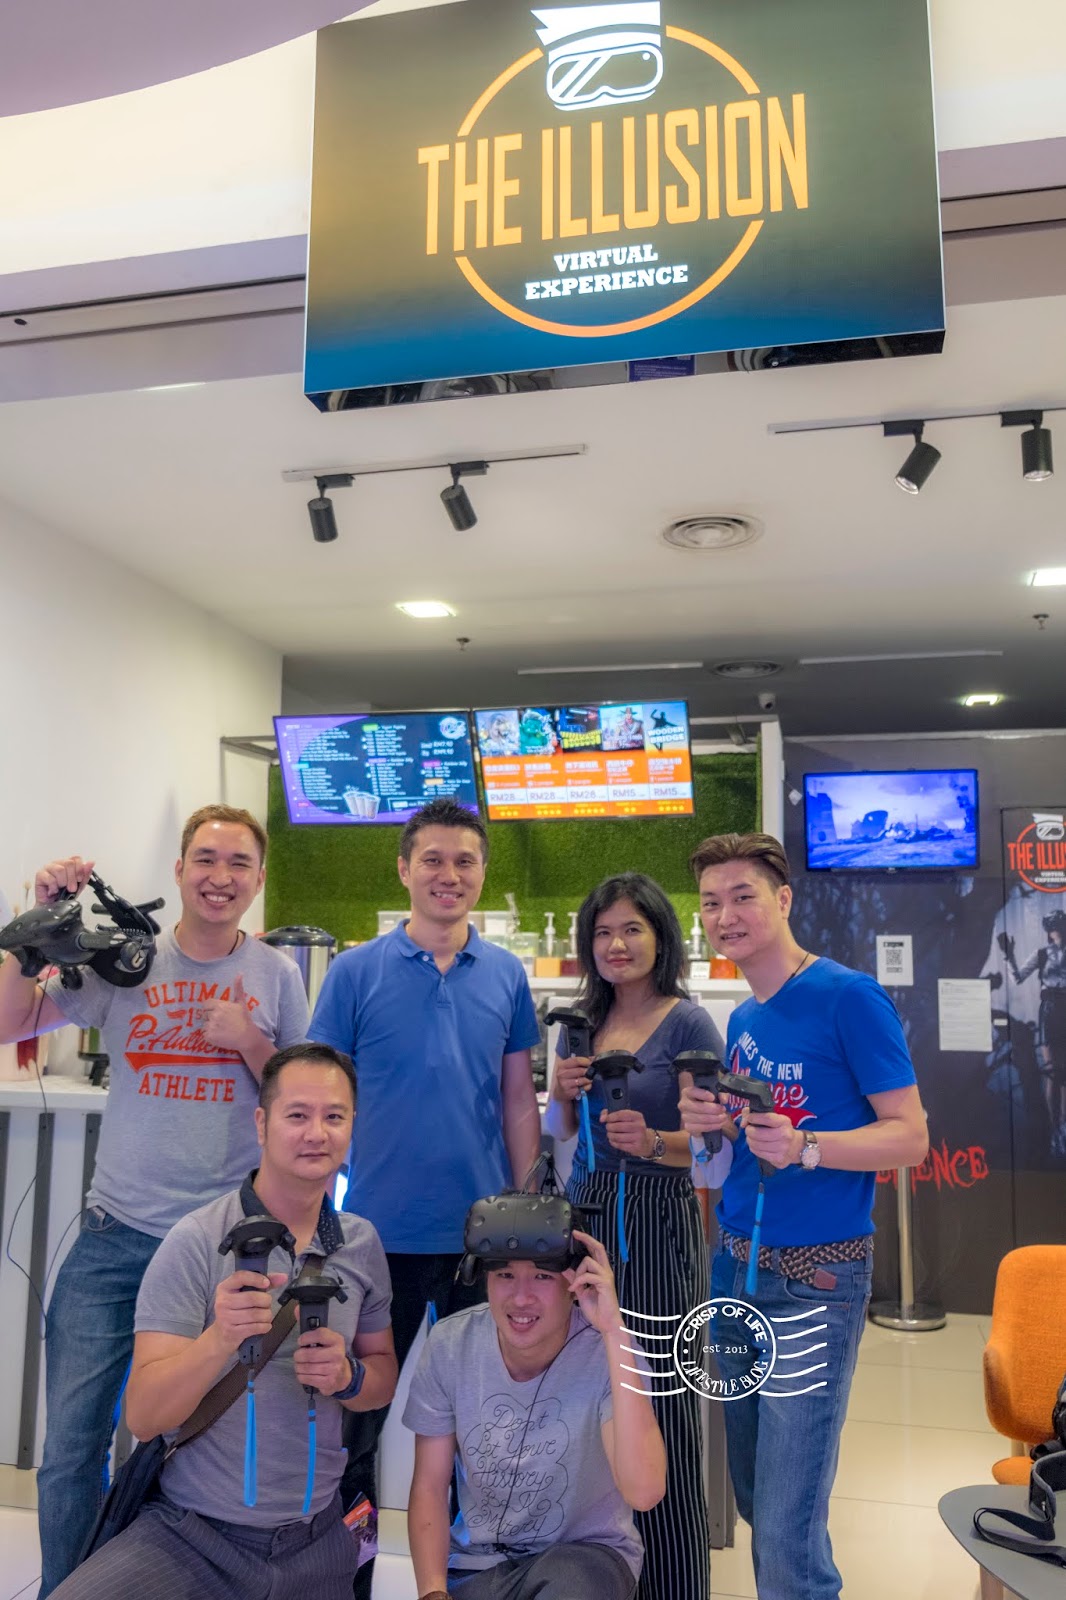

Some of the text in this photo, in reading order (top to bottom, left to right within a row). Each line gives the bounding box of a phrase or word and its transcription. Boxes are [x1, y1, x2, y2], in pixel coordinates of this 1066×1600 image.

[418, 93, 809, 255] THE ILLUSION
[553, 243, 658, 273] VIRTUAL
[525, 265, 689, 300] EXPERIENCE
[647, 726, 685, 736] WOODEN
[650, 733, 685, 744] BRIDGE
[1007, 842, 1035, 870] THE
[144, 981, 260, 1012] ULTIMAE
[756, 1055, 775, 1078] THE
[777, 1062, 803, 1080] NEW
[138, 1072, 236, 1102] ATHLETE
[467, 1431, 501, 1458] Let
